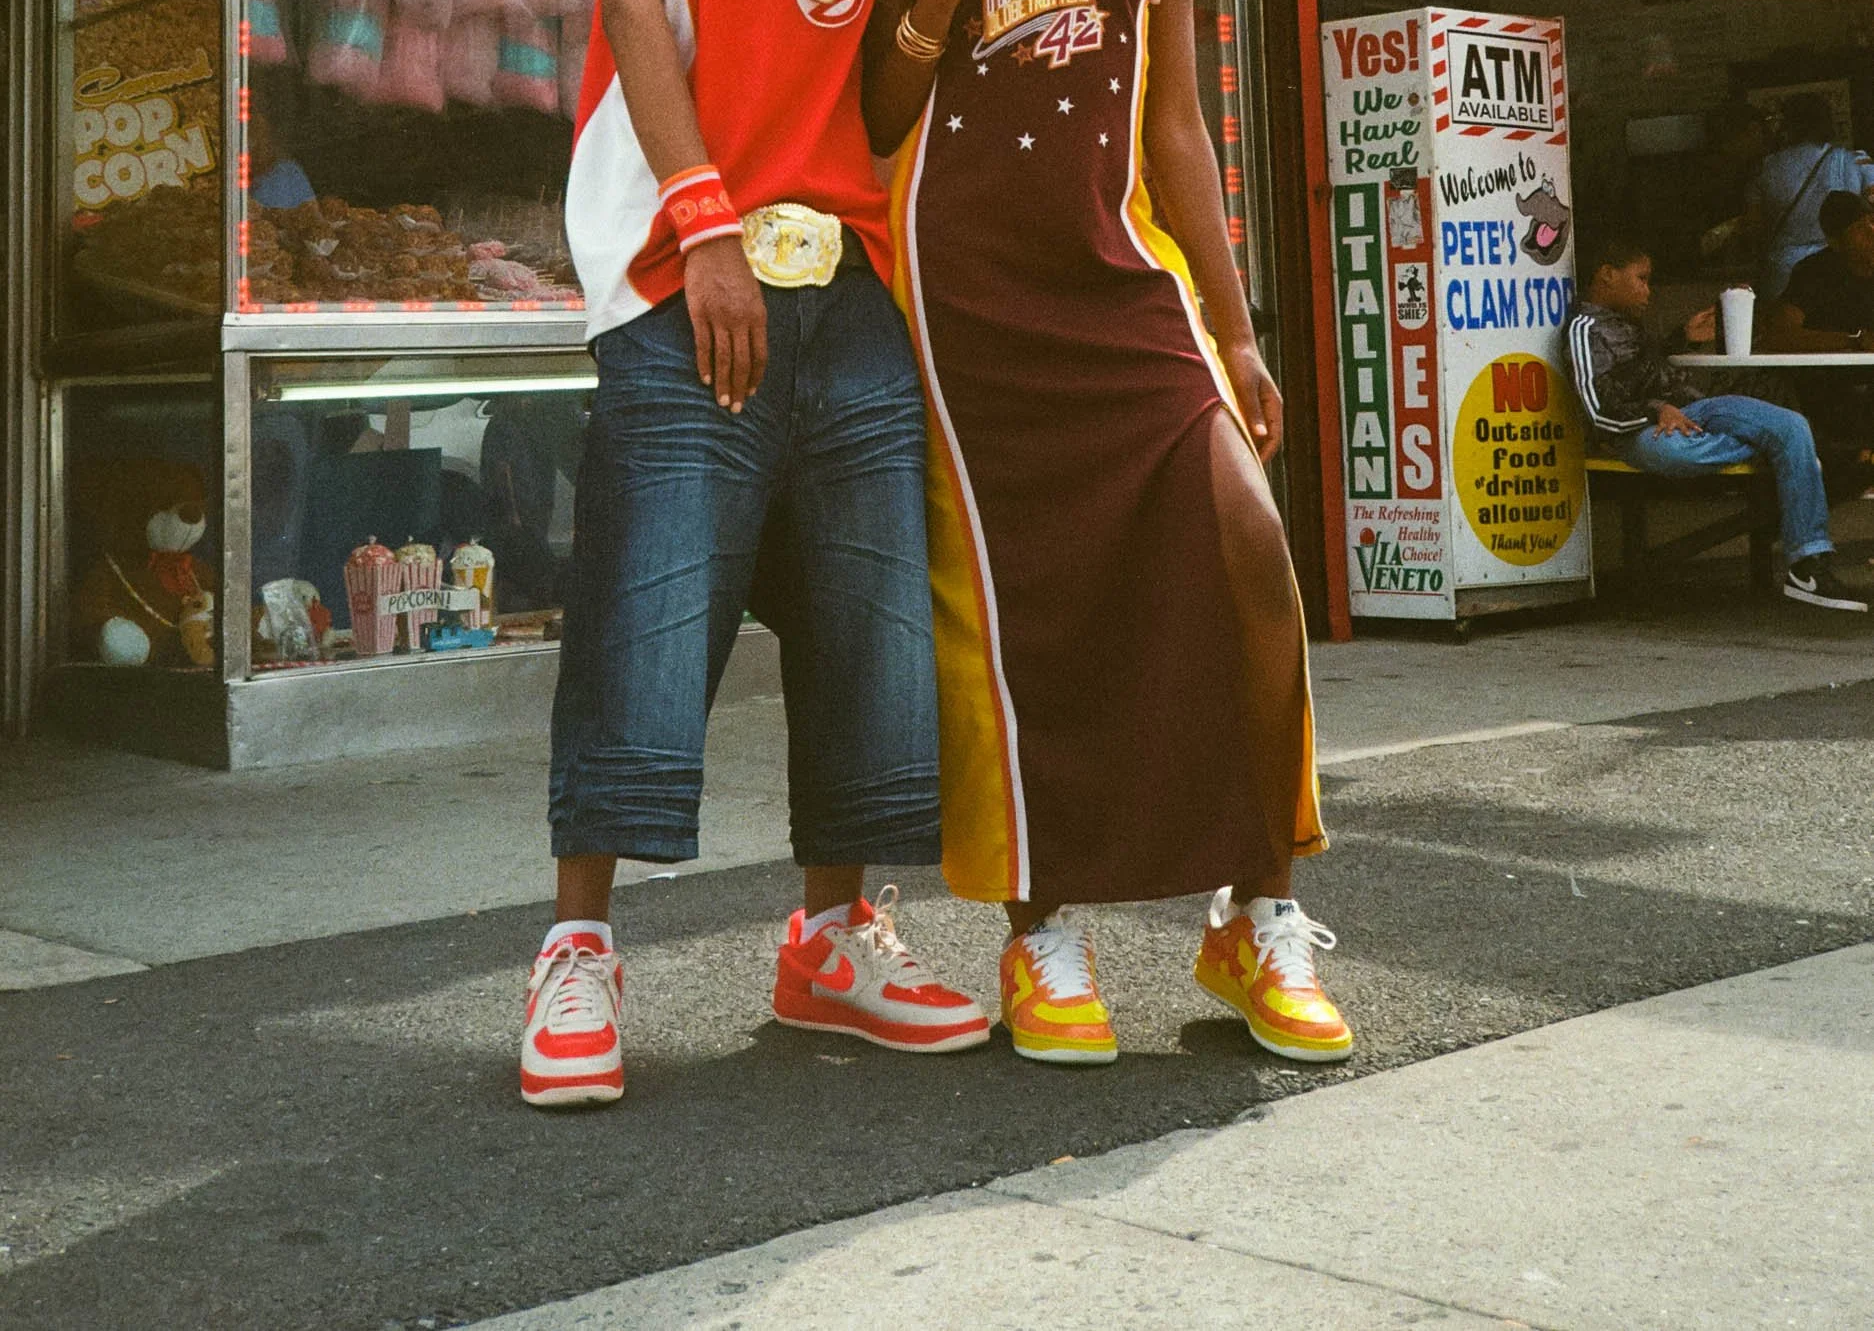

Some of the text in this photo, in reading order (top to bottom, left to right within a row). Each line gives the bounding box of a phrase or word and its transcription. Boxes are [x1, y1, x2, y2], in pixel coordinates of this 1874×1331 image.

[1035, 6, 1102, 67] 42
[1332, 19, 1419, 80] Yes!
[1461, 43, 1544, 105] ATM
[1353, 87, 1403, 116] We
[1458, 101, 1548, 125] AVAILABLE
[74, 98, 174, 155] POP
[1340, 119, 1421, 147] Have
[73, 125, 210, 205] CORN
[1345, 140, 1419, 175] Real
[1440, 151, 1536, 207] Welcome to
[1441, 220, 1517, 266] PETE'S
[1447, 276, 1576, 331] CLAM STOP
[1342, 191, 1387, 492] ITALIAN
[1491, 362, 1548, 413] NO
[1475, 418, 1565, 442] Outside
[1486, 474, 1559, 497] drinks
[1354, 506, 1440, 524] The Refreshing
[1398, 527, 1440, 544] Healthy
[1491, 533, 1528, 553] Thank
[1402, 547, 1443, 562] Choice!
[388, 590, 451, 613] POPCORN!
